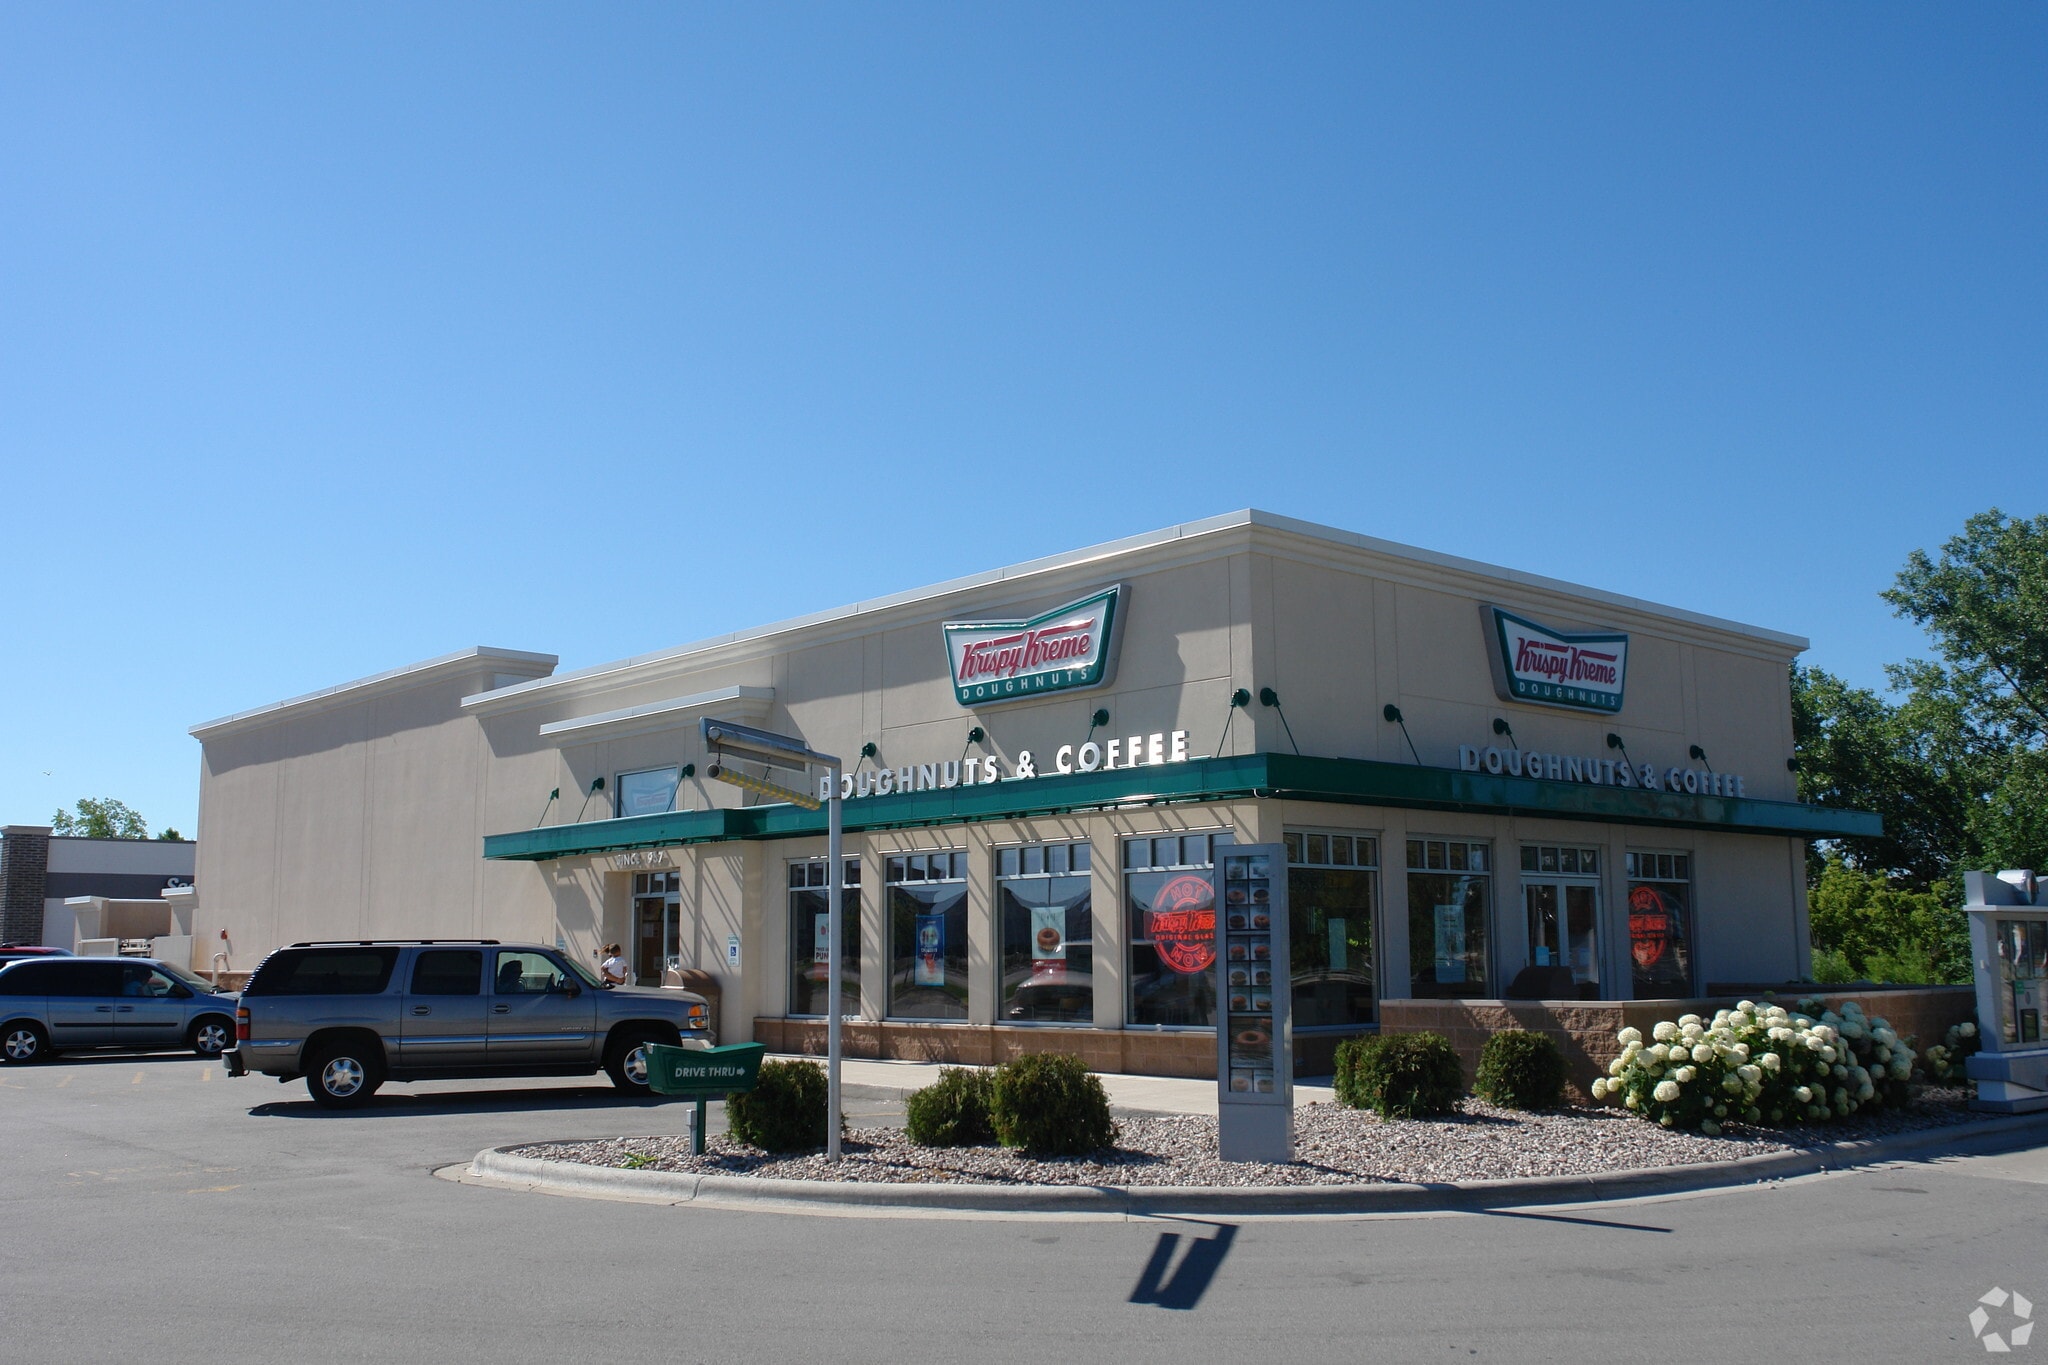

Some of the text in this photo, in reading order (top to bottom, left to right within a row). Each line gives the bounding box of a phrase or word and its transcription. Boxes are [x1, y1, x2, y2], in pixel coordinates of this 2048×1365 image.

[958, 617, 1094, 678] Krispy Kreme
[1515, 637, 1618, 685] Krispy Kreme
[962, 668, 1088, 700] DOUGHNUTS
[1519, 681, 1616, 706] DOUGHNUTS
[1016, 750, 1036, 780] &
[1056, 730, 1188, 775] COFFEE
[1459, 744, 1745, 798] DOUGHNUTS & COFFEE
[1171, 883, 1203, 901] HOT
[1194, 932, 1214, 940] GLAZ
[675, 1066, 736, 1078] DRIVE THRU
